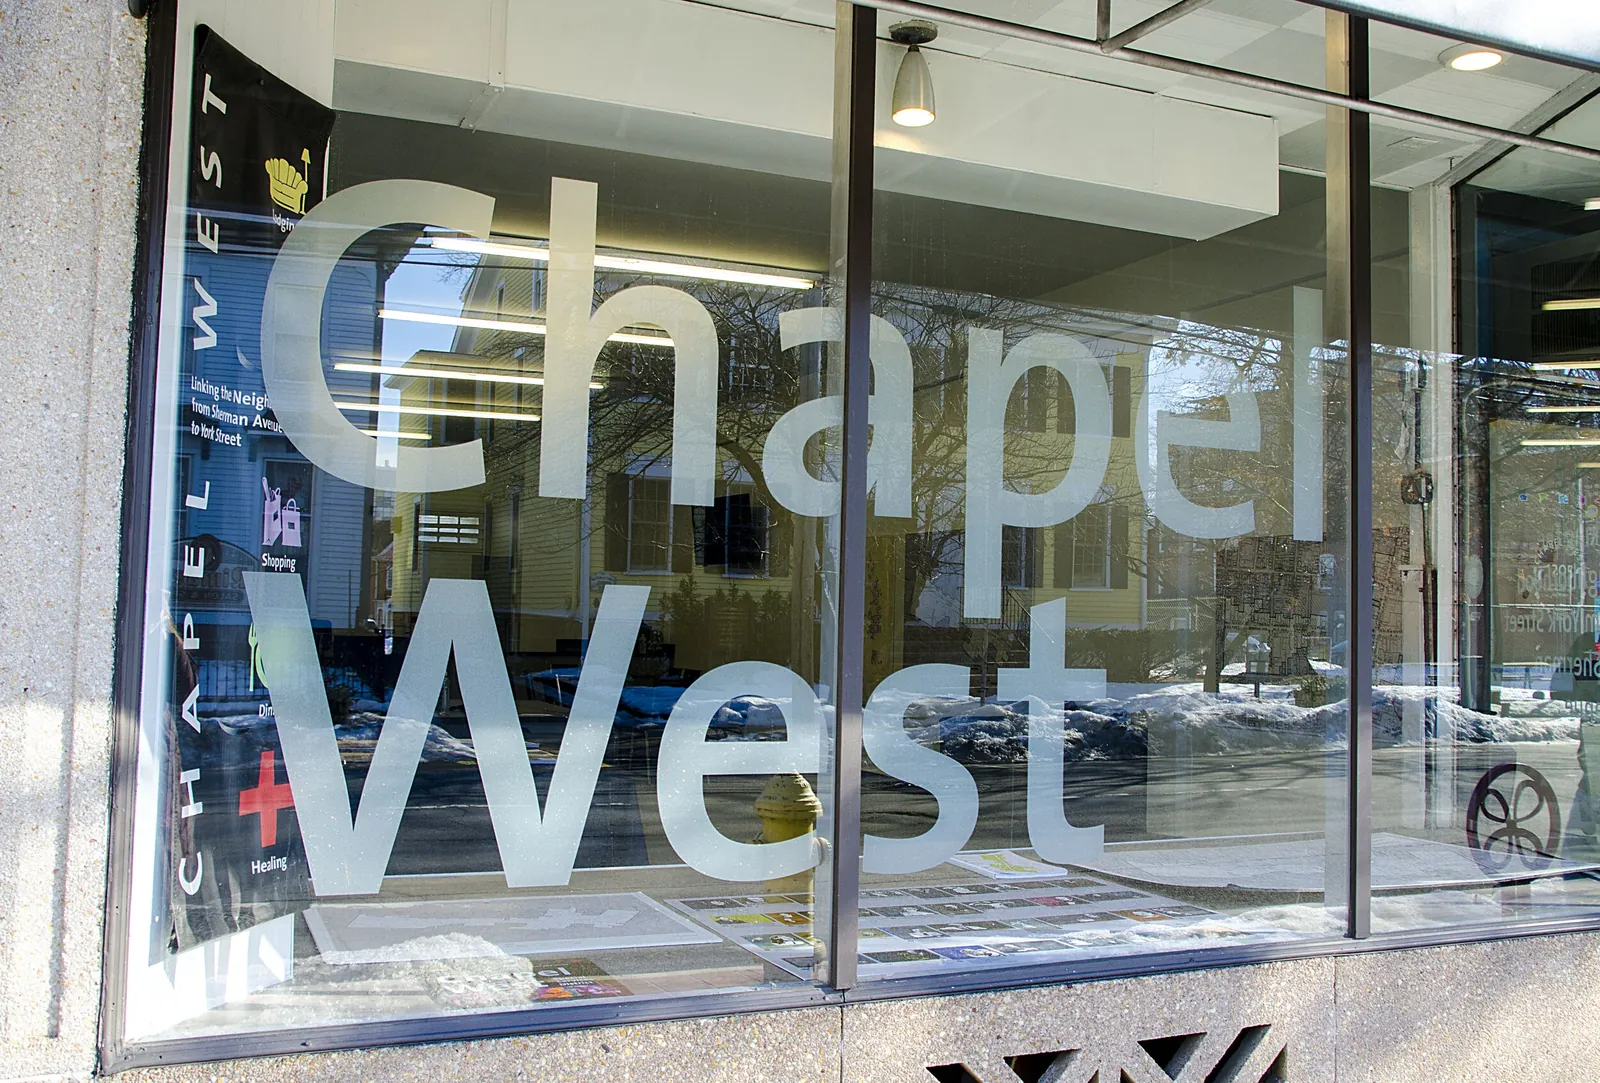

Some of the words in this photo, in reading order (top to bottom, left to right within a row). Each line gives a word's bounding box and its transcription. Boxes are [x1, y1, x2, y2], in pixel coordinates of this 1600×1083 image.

[193, 73, 228, 351] WEST
[191, 375, 219, 402] Linking
[220, 385, 232, 402] the
[232, 389, 272, 411] Neigh
[259, 176, 1324, 620] Chapel
[191, 396, 211, 417] from
[211, 403, 248, 427] Sherman
[252, 413, 283, 433] Avenue
[191, 420, 200, 436] to
[200, 422, 214, 441] York
[215, 427, 242, 447] Street
[261, 552, 297, 573] Shopping
[178, 480, 211, 896] CHAPEL
[258, 702, 275, 718] Din
[241, 570, 1108, 896] West
[251, 855, 288, 875] Healing
